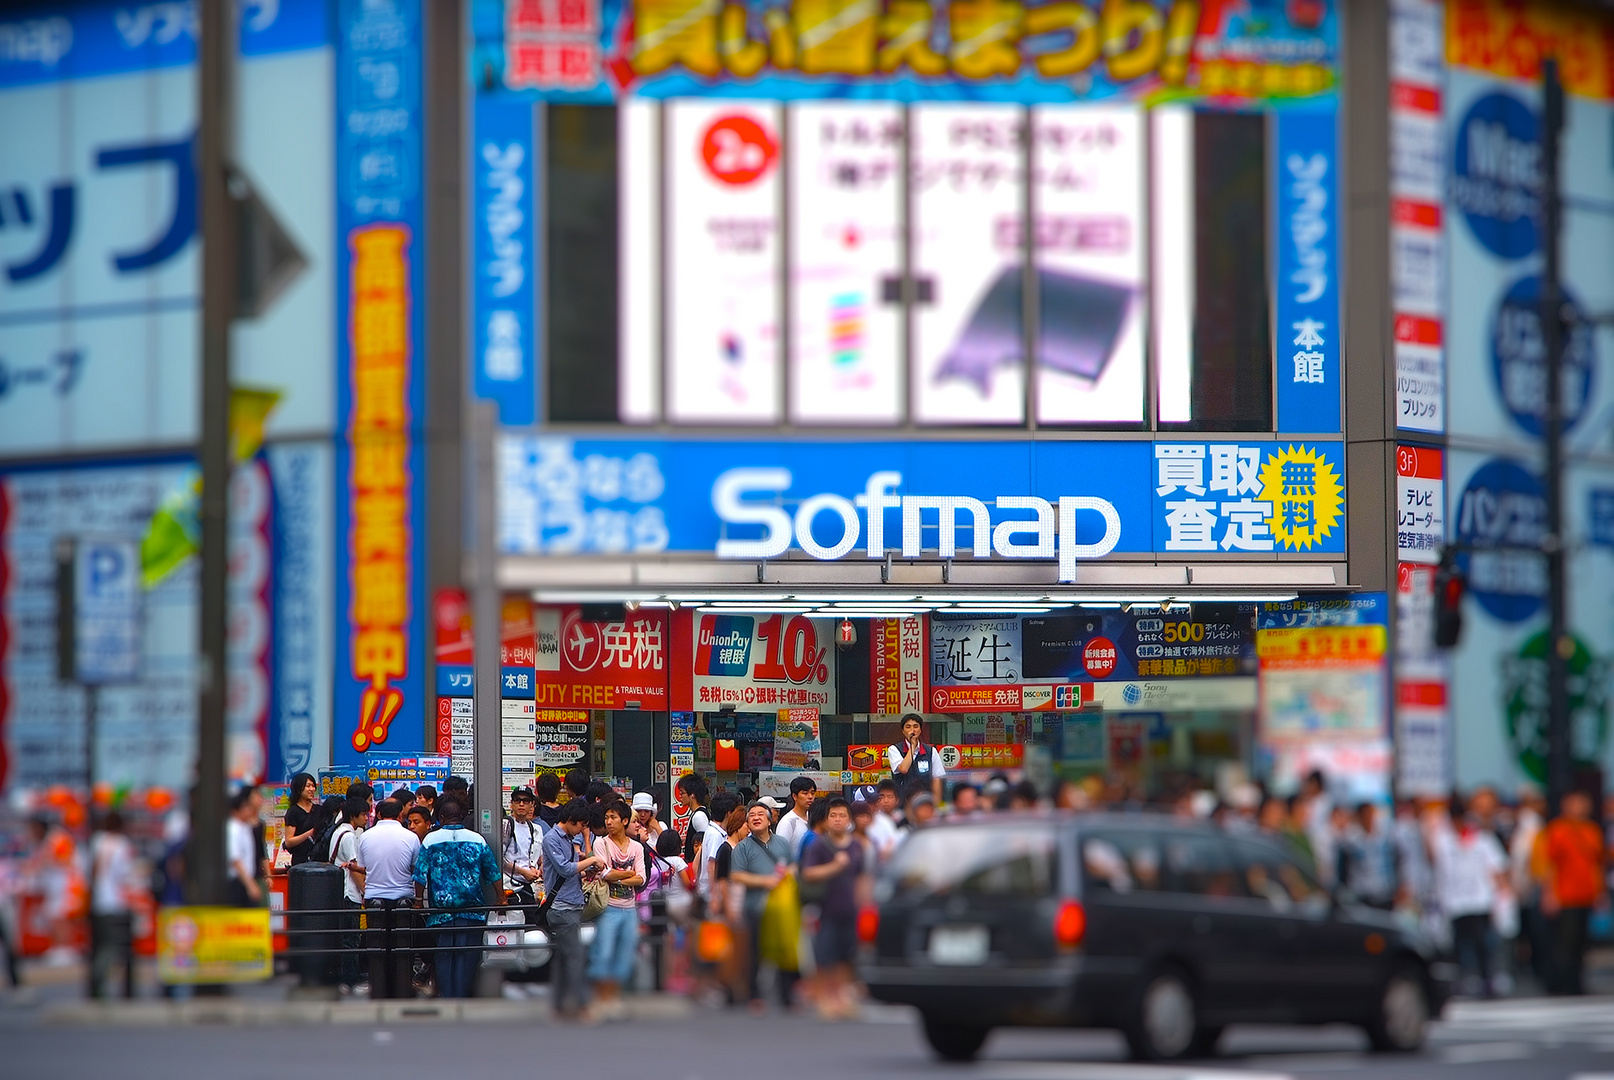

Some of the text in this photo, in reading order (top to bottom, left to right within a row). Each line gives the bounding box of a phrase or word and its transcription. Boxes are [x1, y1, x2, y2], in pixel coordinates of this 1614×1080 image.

[1285, 152, 1329, 384] ソフマップ 本館
[1155, 444, 1264, 497] 買取
[1281, 461, 1317, 536] 無料
[1406, 489, 1433, 507] テレビ
[711, 466, 1121, 583] Sofmap
[1165, 498, 1275, 551] 査定
[1398, 512, 1442, 528] レコーダー
[1138, 621, 1161, 630] 特典1
[1164, 621, 1205, 643] 500
[536, 640, 558, 654] APAN
[602, 618, 663, 670] 免税
[700, 629, 750, 652] UnionPay
[902, 617, 920, 658] 免税
[1137, 633, 1163, 642] もれなく
[719, 649, 746, 665] 银联
[752, 613, 829, 685] 10%
[876, 626, 885, 672] TRAVEL
[1084, 648, 1115, 659] 新規会員
[1138, 647, 1161, 656] 特典2
[1087, 659, 1113, 670] 募集中!
[505, 674, 529, 690] 本館
[886, 667, 898, 714] FREE
[903, 669, 920, 711] 면세
[536, 683, 567, 705] UTY
[572, 684, 614, 706] FREE
[621, 686, 644, 695] TRAVEL
[644, 687, 664, 696] VALUE
[876, 676, 885, 714] VALUE
[950, 690, 993, 700] DUTY FREE
[994, 689, 1019, 705] 免税
[1056, 693, 1079, 702] JCB
[368, 759, 400, 767] ソフマップ
[943, 754, 955, 763] 3F
